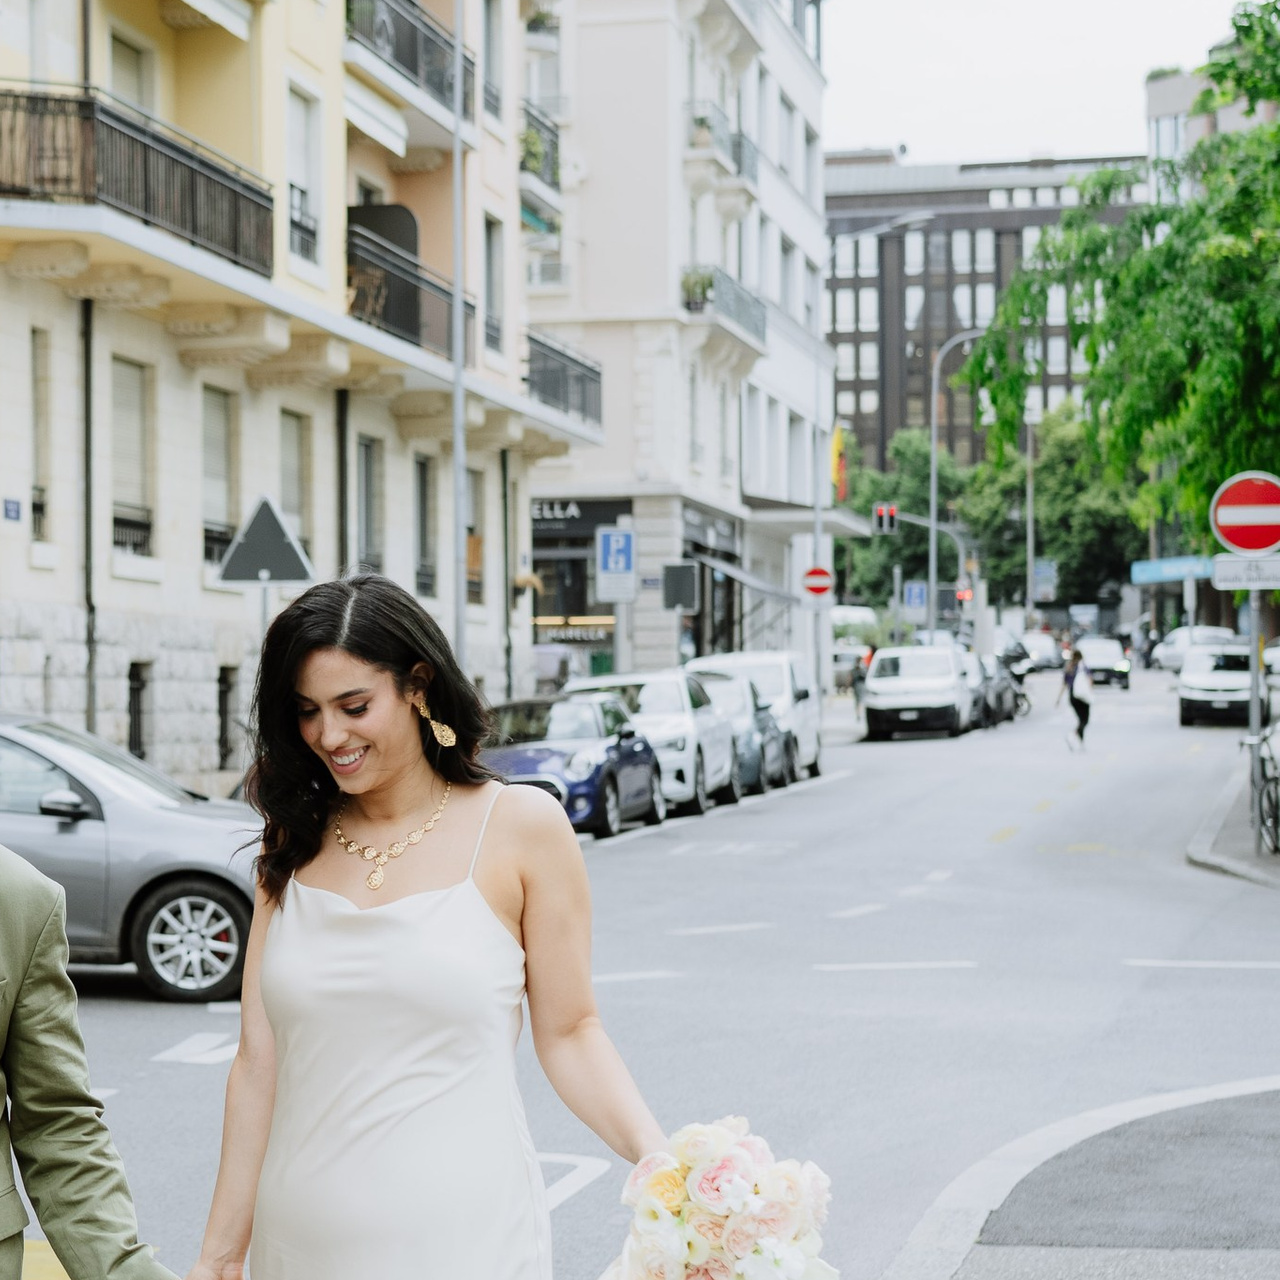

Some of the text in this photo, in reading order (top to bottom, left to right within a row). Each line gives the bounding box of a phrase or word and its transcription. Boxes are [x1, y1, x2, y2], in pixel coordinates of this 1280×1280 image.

[532, 502, 581, 519] ELLA
[610, 535, 625, 555] P
[547, 627, 606, 641] MARELLA
